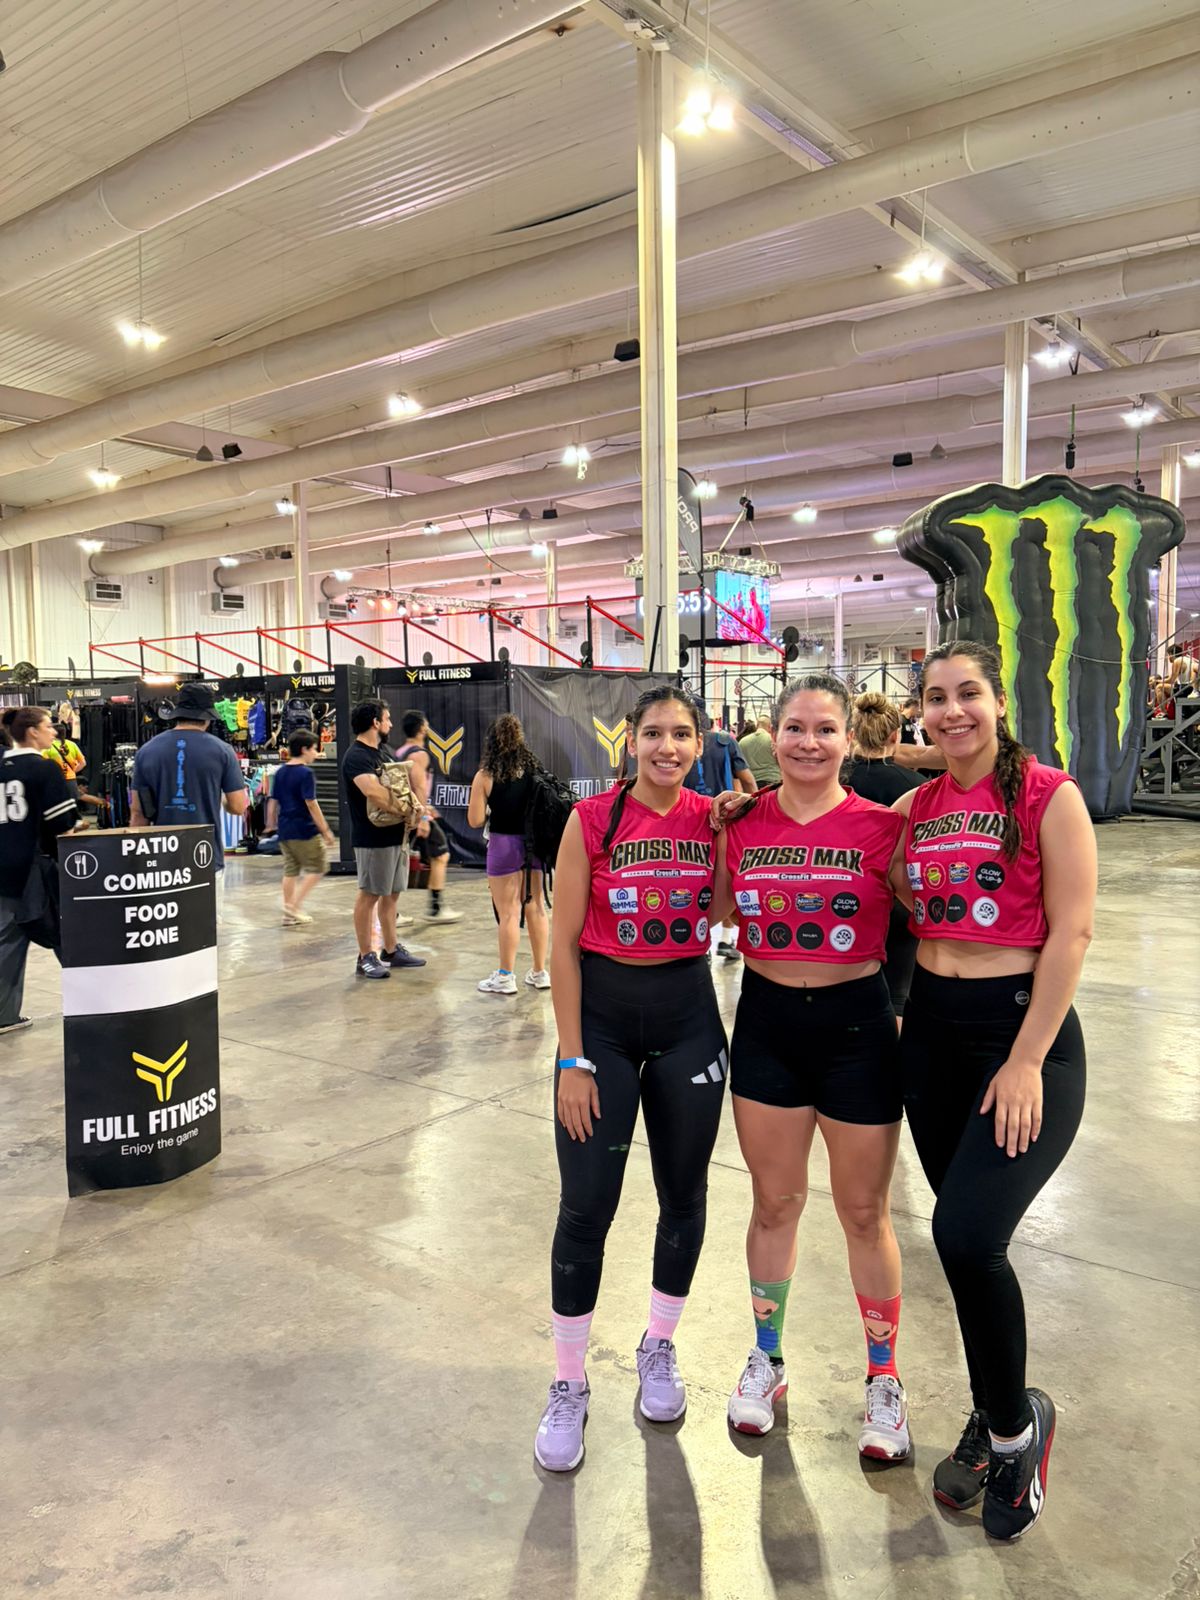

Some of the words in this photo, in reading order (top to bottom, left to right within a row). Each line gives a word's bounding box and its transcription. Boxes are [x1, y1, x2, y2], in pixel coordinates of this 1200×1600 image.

[301, 676, 317, 687] FULL
[318, 675, 336, 686] FITN
[419, 669, 437, 681] FULL
[439, 667, 471, 680] FITNESS
[435, 784, 472, 807] FITN
[910, 809, 967, 850] CROSS
[121, 835, 179, 856] PATIO
[609, 837, 674, 874] CROSS
[146, 860, 158, 868] DE
[737, 845, 809, 876] CROSS
[811, 846, 864, 877] MAX
[980, 868, 1002, 876] GLOW
[103, 867, 192, 892] COMIDAS
[124, 901, 179, 924] FOOD
[125, 926, 179, 949] ZONE
[82, 1114, 140, 1144] FULL
[148, 1087, 217, 1135] FITNESS
[121, 1142, 154, 1156] Enjoy
[157, 1135, 174, 1149] the
[176, 1127, 199, 1146] game
